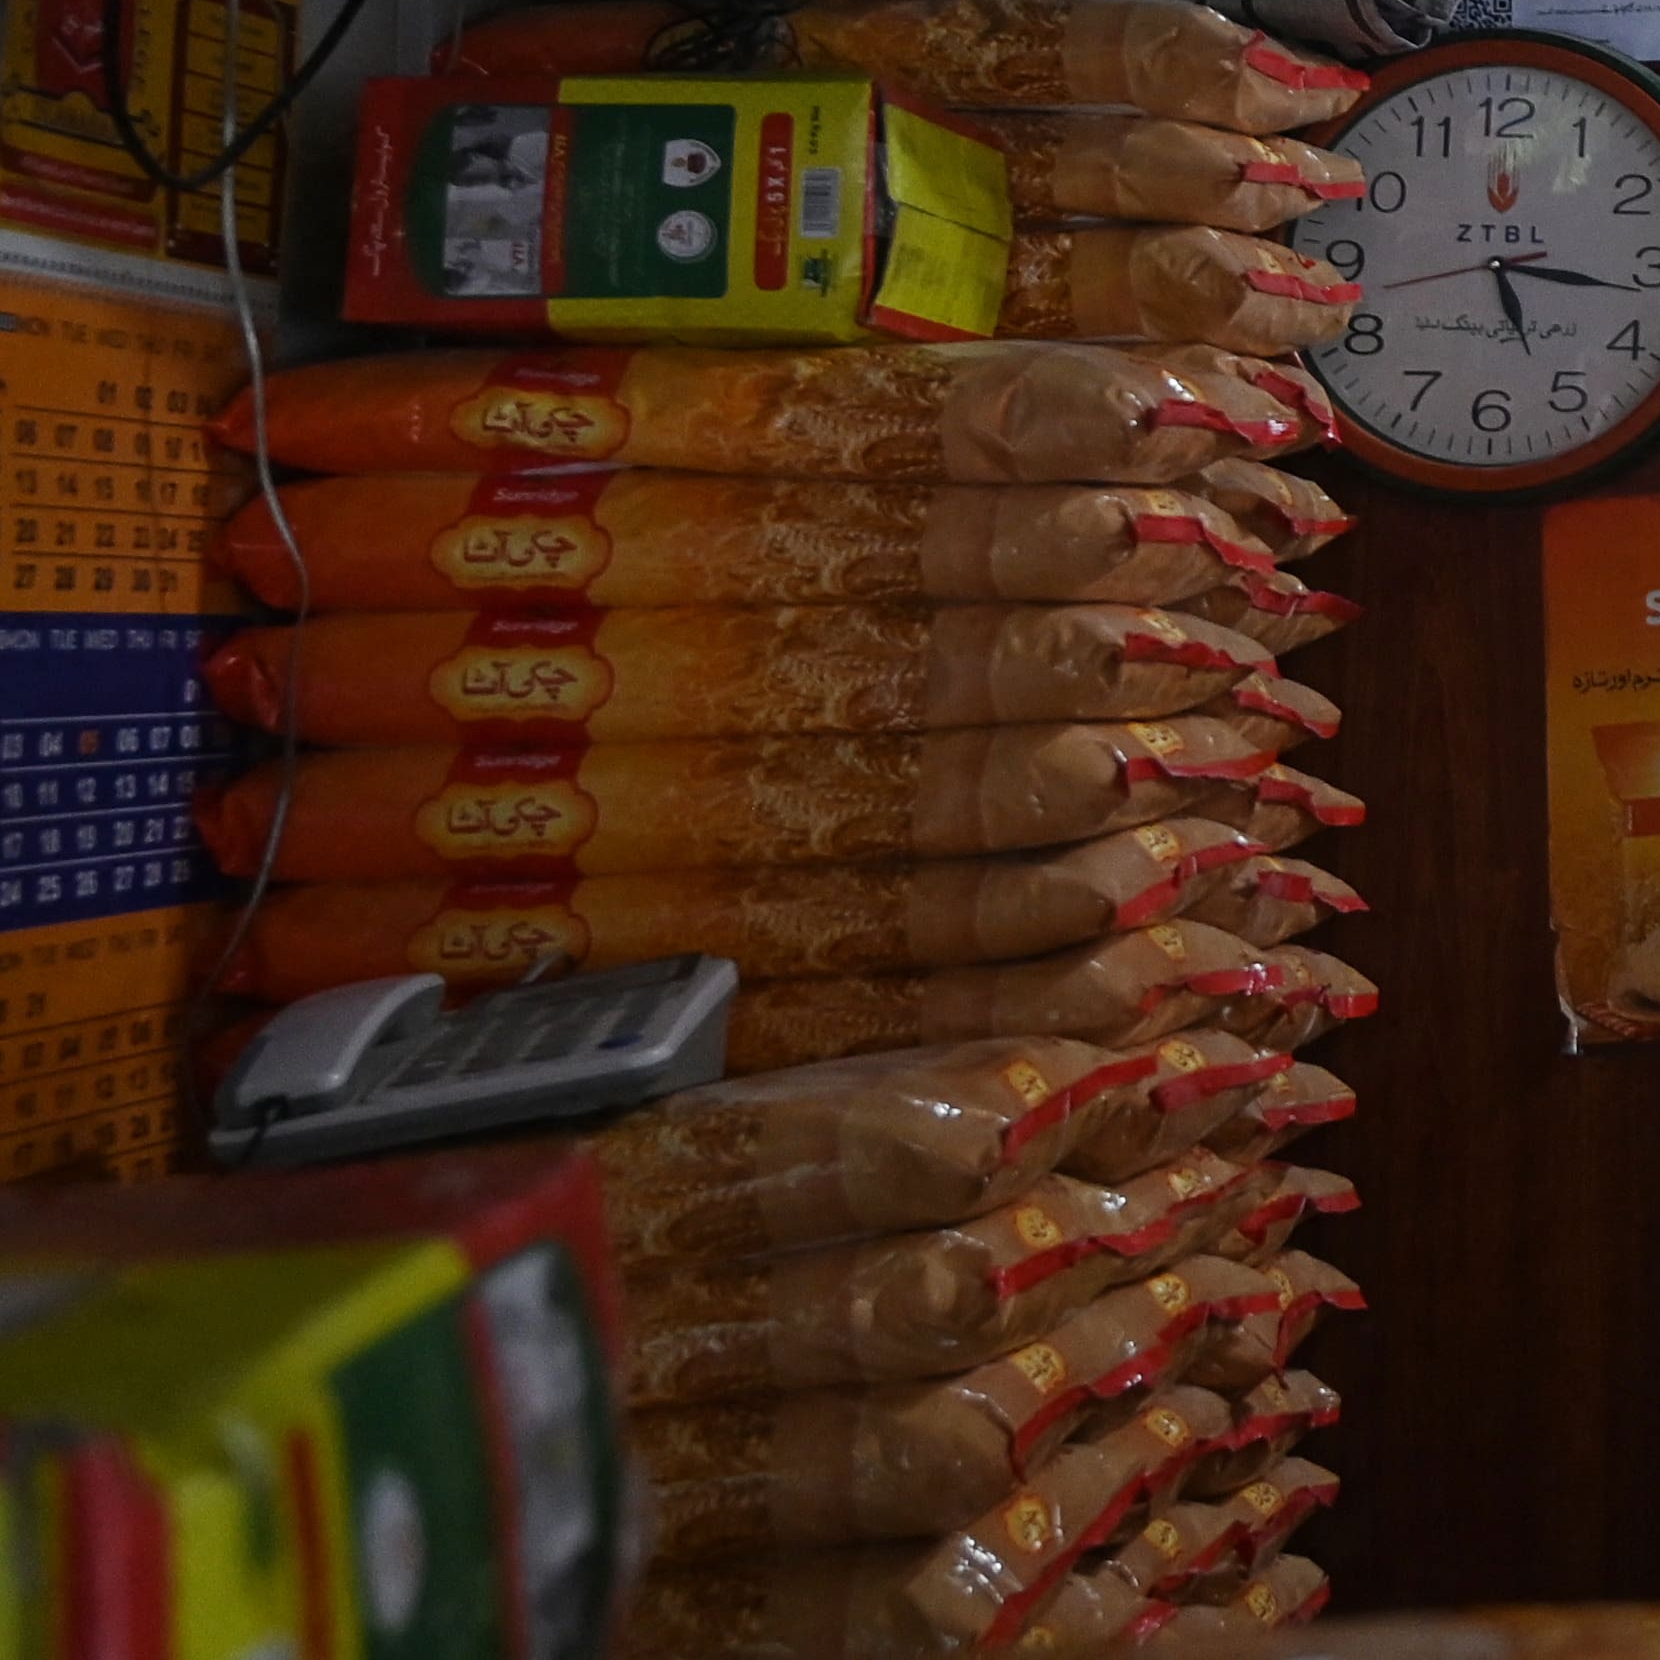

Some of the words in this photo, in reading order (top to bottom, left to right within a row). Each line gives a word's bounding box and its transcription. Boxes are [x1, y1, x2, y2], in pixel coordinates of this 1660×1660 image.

[1410, 116, 1452, 158] 11
[1478, 97, 1536, 139] 12
[1572, 117, 1586, 158] 1
[1613, 174, 1651, 215] 2
[1457, 223, 1545, 244] ZTBL
[1326, 240, 1365, 282] 9
[1343, 314, 1385, 356] 8
[1606, 320, 1647, 360] 4
[1403, 370, 1442, 412] 7
[1471, 390, 1513, 432] 6
[1548, 370, 1588, 413] 5
